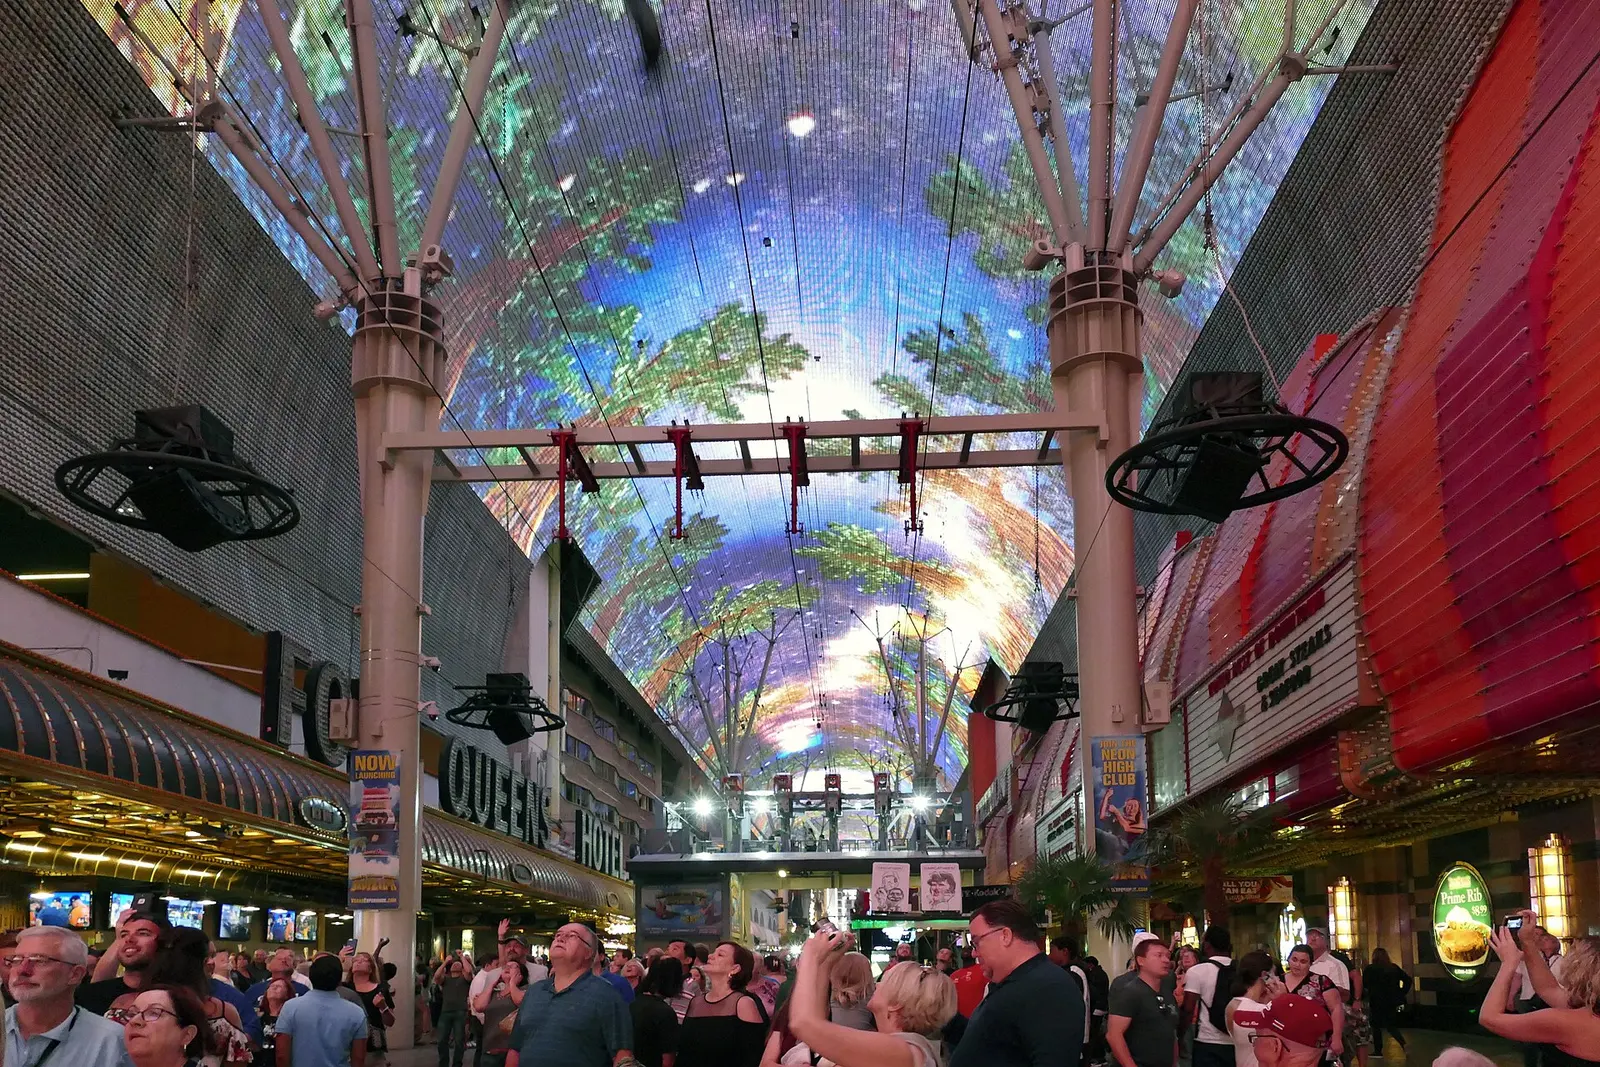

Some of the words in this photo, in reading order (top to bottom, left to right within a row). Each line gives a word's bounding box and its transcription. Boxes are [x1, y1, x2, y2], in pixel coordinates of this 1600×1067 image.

[1101, 748, 1136, 761] NEON
[354, 754, 397, 772] NOW
[1103, 761, 1135, 773] HIGH
[355, 771, 396, 780] LAUNCHING
[1102, 773, 1136, 786] CLUB
[441, 735, 552, 851] QUEENS
[577, 809, 630, 882] HOTEL
[1440, 890, 1466, 905] Prime
[1467, 887, 1483, 903] Rib
